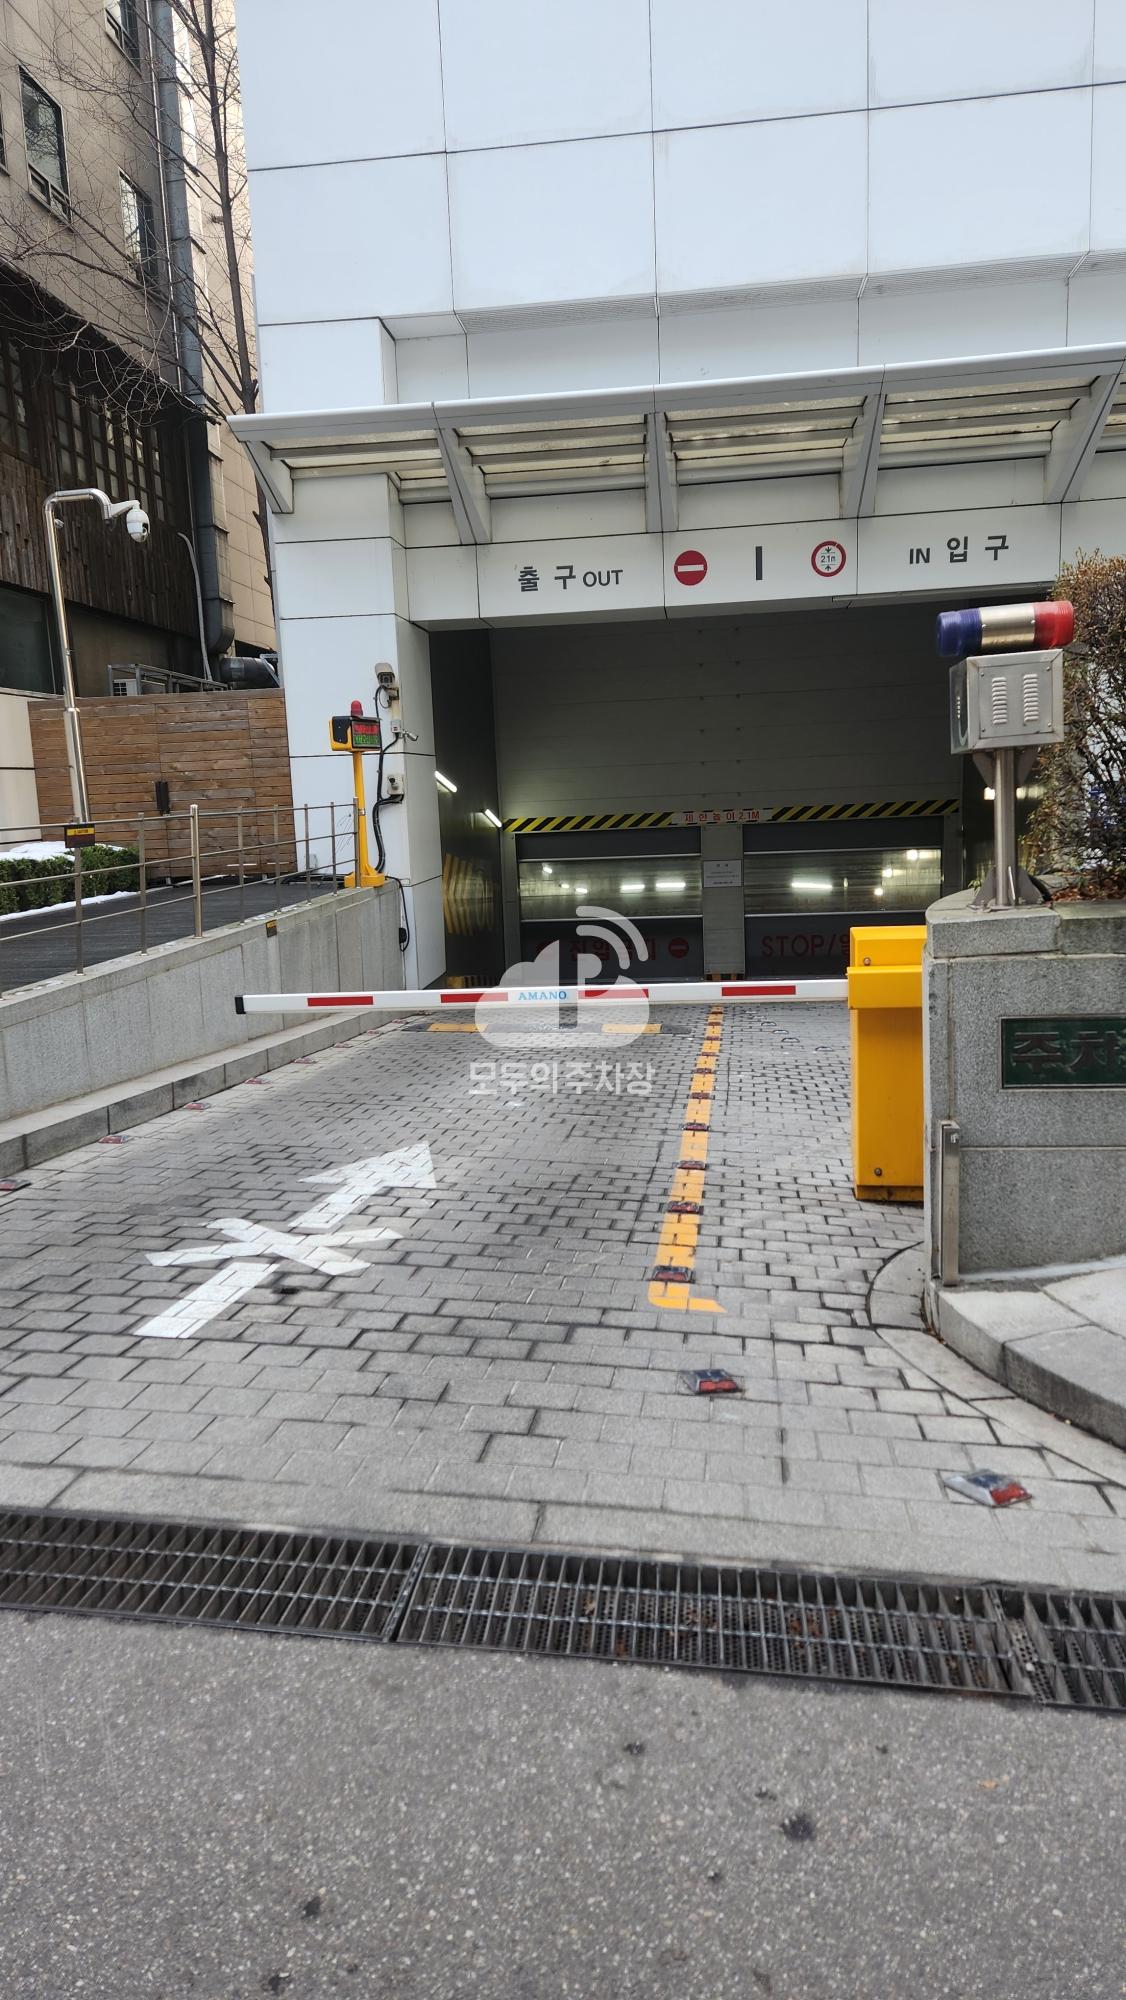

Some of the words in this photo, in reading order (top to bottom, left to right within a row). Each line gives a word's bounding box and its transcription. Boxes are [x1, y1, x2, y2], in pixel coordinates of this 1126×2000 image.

[909, 547, 931, 565] IN
[582, 569, 624, 588] OUT
[517, 990, 568, 1002] AMANO
